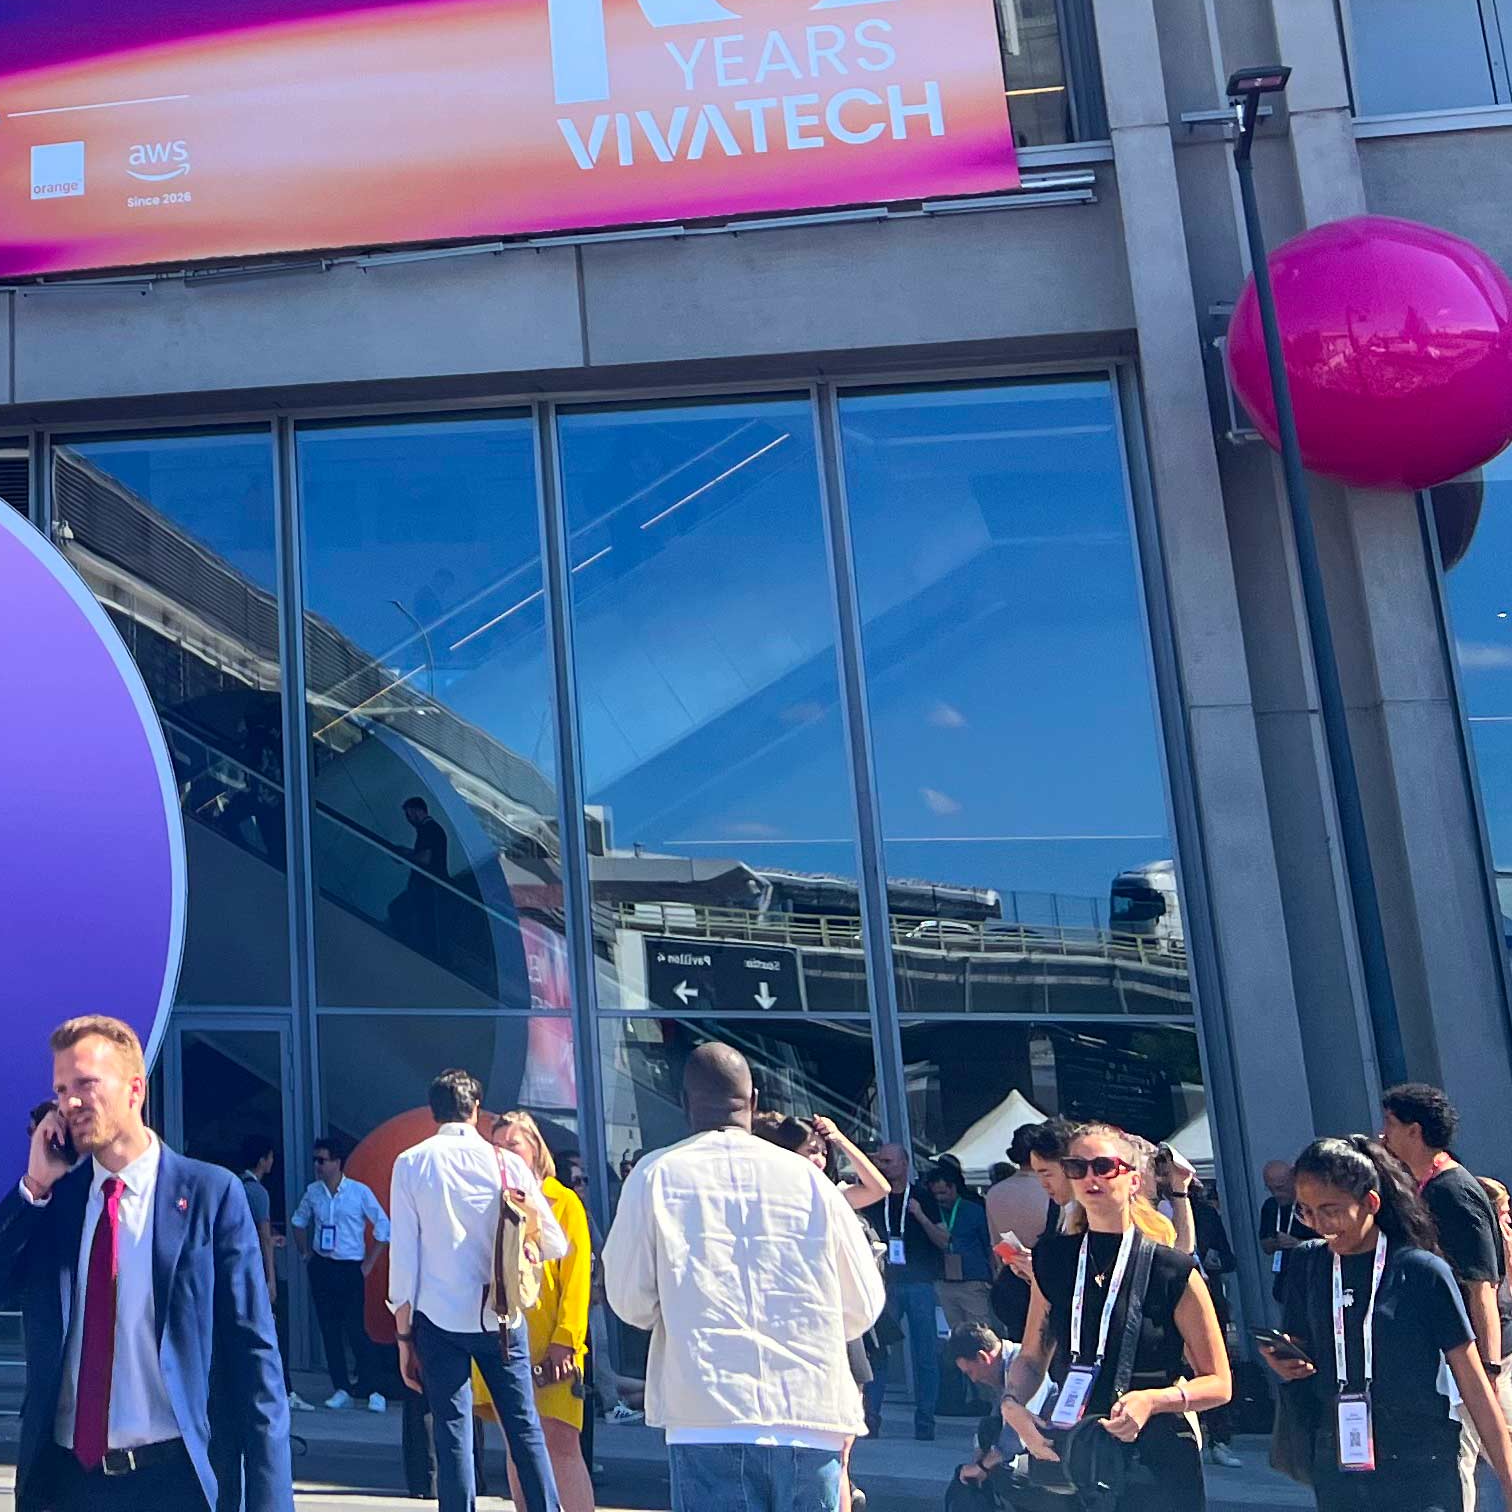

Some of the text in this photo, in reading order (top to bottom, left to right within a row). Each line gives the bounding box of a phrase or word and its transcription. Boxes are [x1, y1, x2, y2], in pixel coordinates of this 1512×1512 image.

[664, 18, 897, 90] YEARS
[556, 80, 945, 170] VIVATECH
[129, 140, 189, 166] aws
[32, 180, 79, 195] orange
[127, 195, 161, 208] Since
